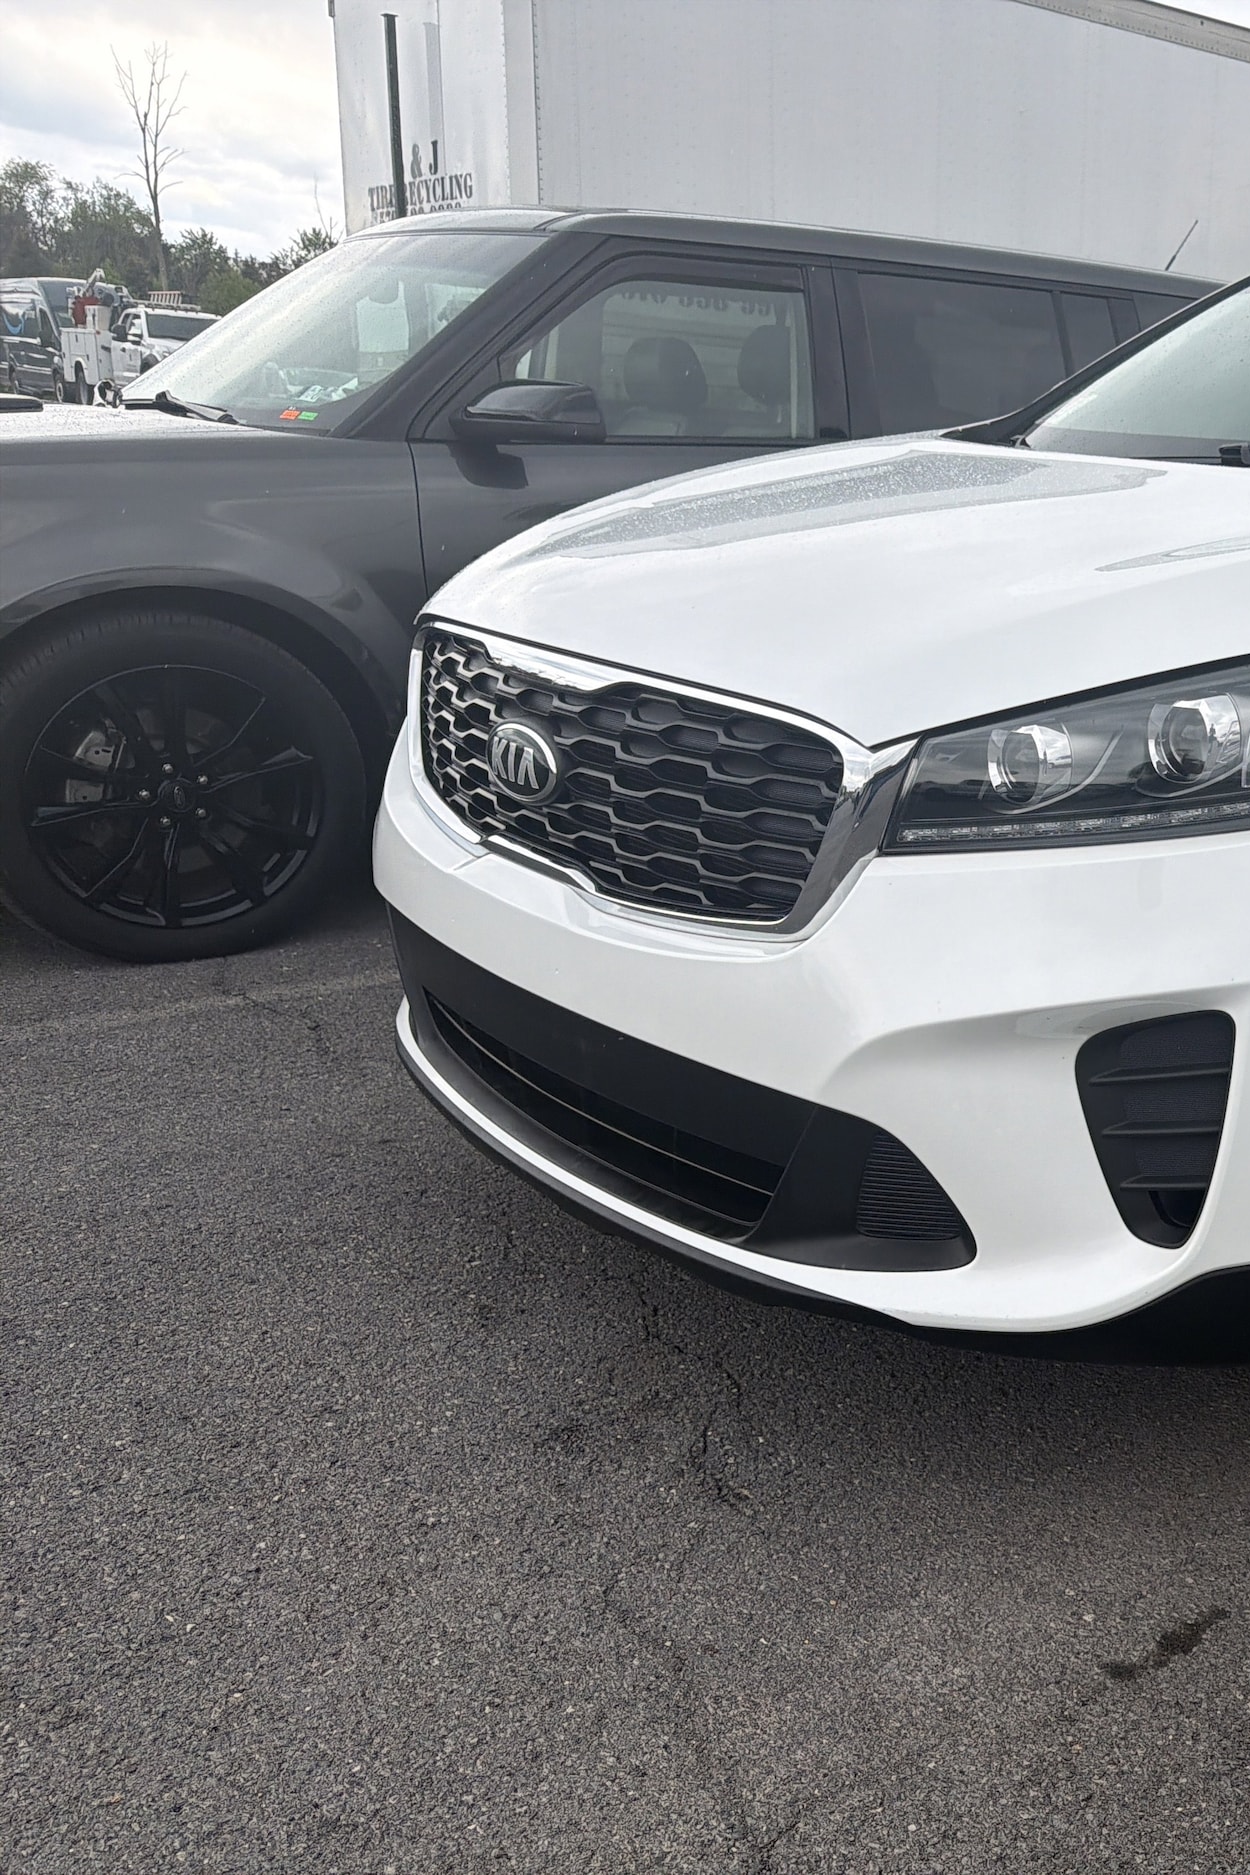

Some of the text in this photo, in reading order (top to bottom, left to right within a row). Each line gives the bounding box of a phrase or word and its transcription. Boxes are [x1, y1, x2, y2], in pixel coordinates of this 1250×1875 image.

[410, 139, 438, 180] & J
[491, 736, 539, 789] KIA
